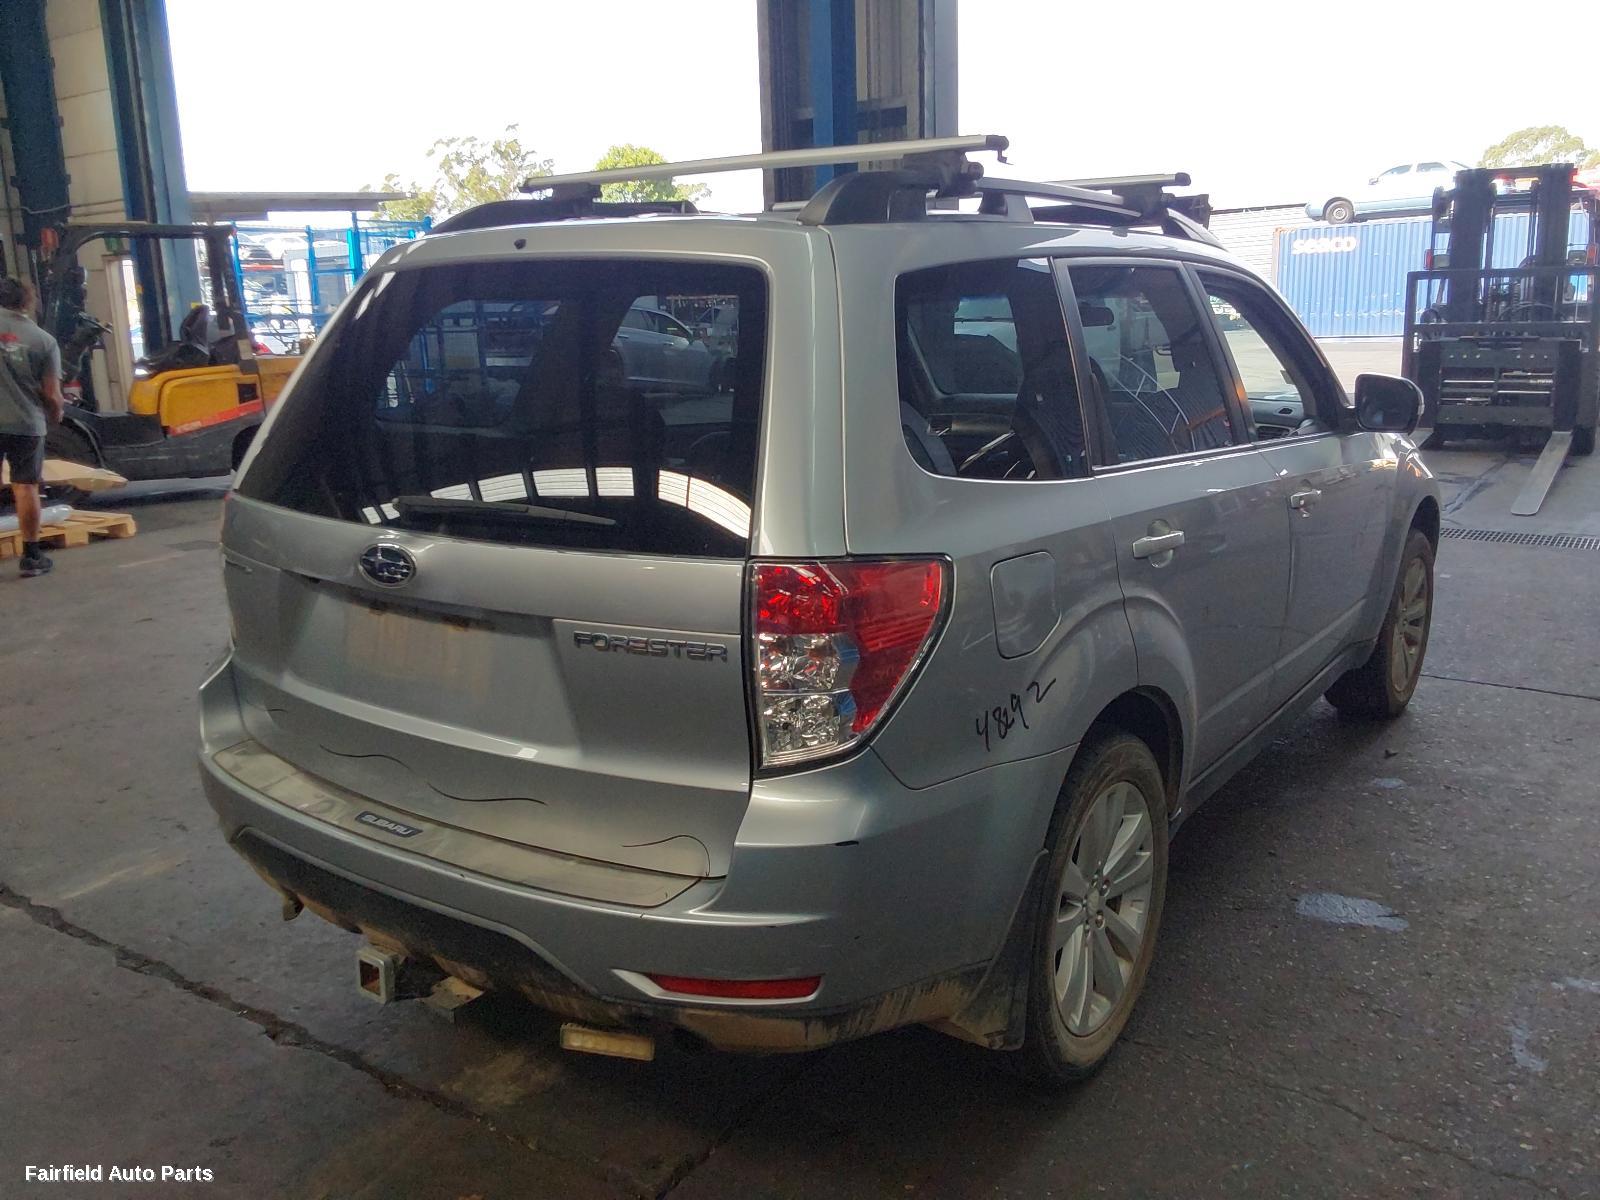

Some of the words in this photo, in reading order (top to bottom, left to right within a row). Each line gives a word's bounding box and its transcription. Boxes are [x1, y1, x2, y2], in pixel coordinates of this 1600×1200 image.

[1291, 236, 1357, 255] seaco
[573, 630, 728, 662] FORESTER
[359, 813, 416, 836] SUBARU
